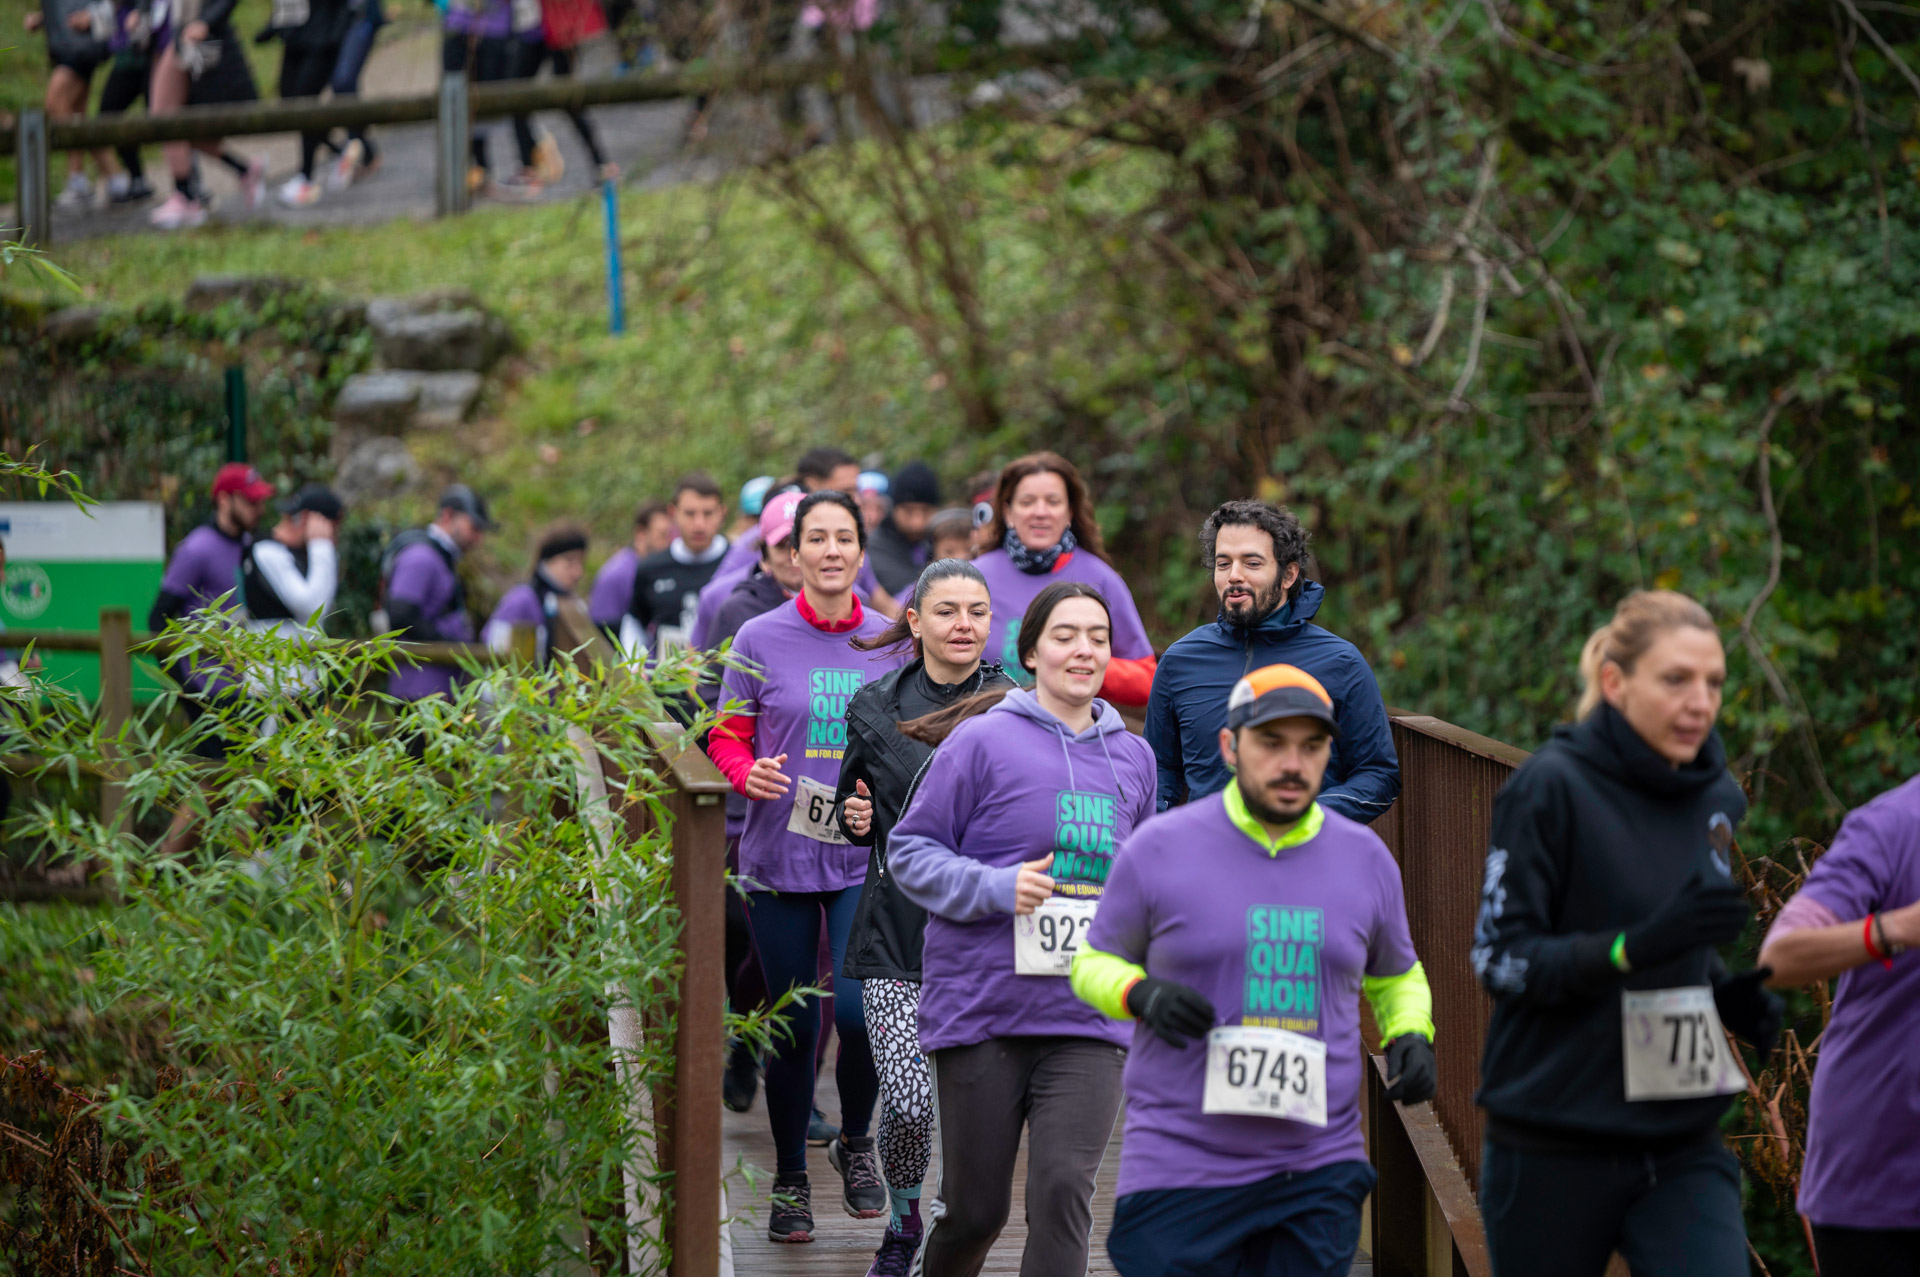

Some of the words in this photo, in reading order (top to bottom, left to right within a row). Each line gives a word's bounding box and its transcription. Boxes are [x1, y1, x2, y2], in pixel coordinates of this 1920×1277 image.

[812, 671, 861, 694] SINE
[812, 695, 853, 720] QU
[805, 749, 818, 758] RUN
[819, 749, 832, 759] FOR
[1060, 794, 1114, 826] SINE
[1059, 823, 1114, 855] QUA
[1052, 851, 1113, 883] NON
[1062, 884, 1076, 895] FOR
[1252, 907, 1319, 942] SINE
[1251, 941, 1316, 977] QUA
[1248, 977, 1315, 1012] NON
[1242, 1015, 1261, 1027] RUN
[1262, 1016, 1280, 1029] FOR
[1281, 1017, 1318, 1033] EQUALITY
[1228, 1046, 1308, 1095] 6743
